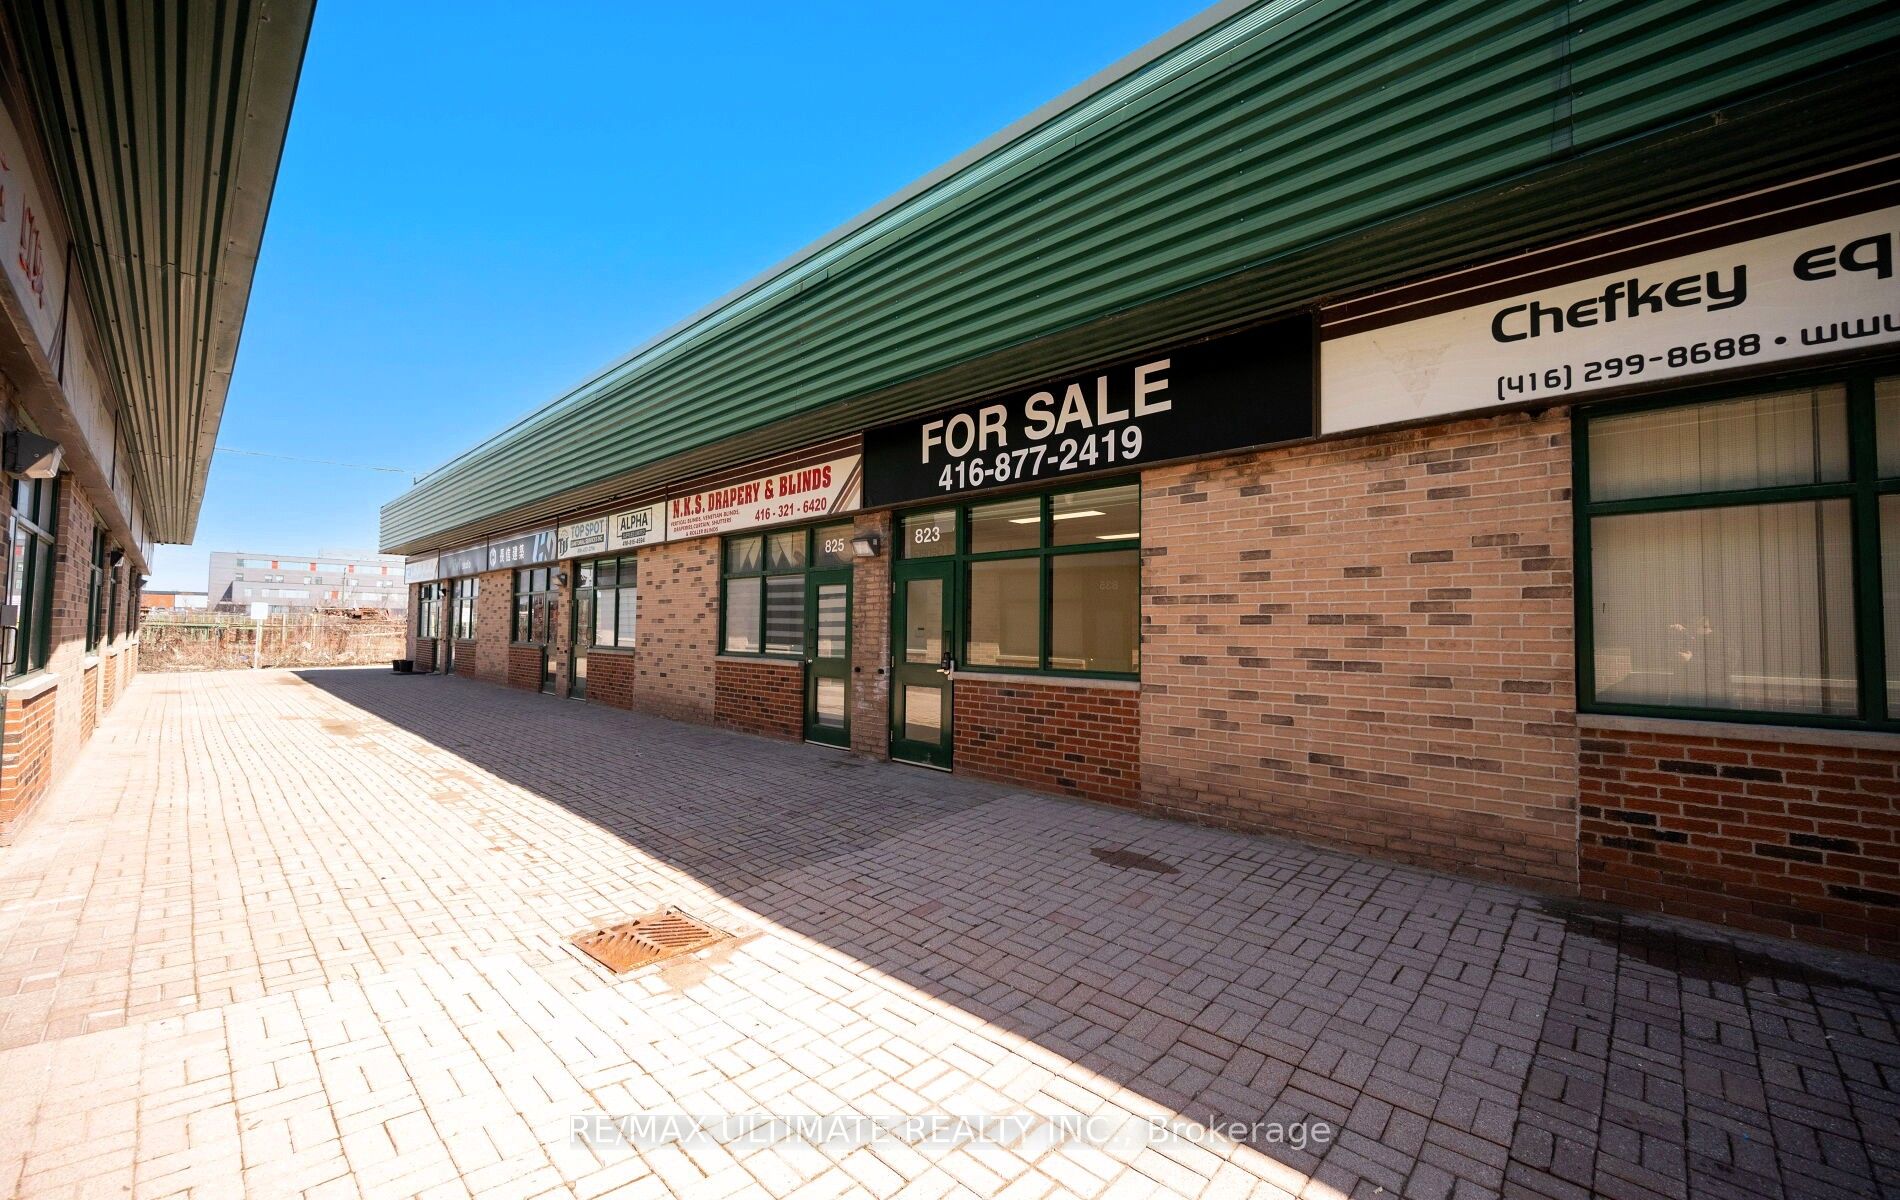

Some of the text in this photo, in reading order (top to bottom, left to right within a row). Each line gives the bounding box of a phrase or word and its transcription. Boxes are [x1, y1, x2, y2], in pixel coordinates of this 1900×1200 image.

[1491, 232, 1900, 343] Chefkey eq
[1497, 364, 1573, 401] (416)
[1584, 333, 1761, 383] 299-8688
[922, 358, 1172, 465] FOR SALE
[938, 425, 1143, 491] 416-877-2419
[673, 465, 832, 519] N.K.S. DRAPERY & BLINDS
[755, 508, 771, 522] 416
[778, 503, 794, 518] 321
[803, 497, 827, 514] 6420
[570, 523, 585, 538] TOP
[585, 519, 605, 537] SPOT
[620, 512, 648, 531] ALPHA
[915, 526, 940, 544] 823
[824, 538, 845, 553] 825
